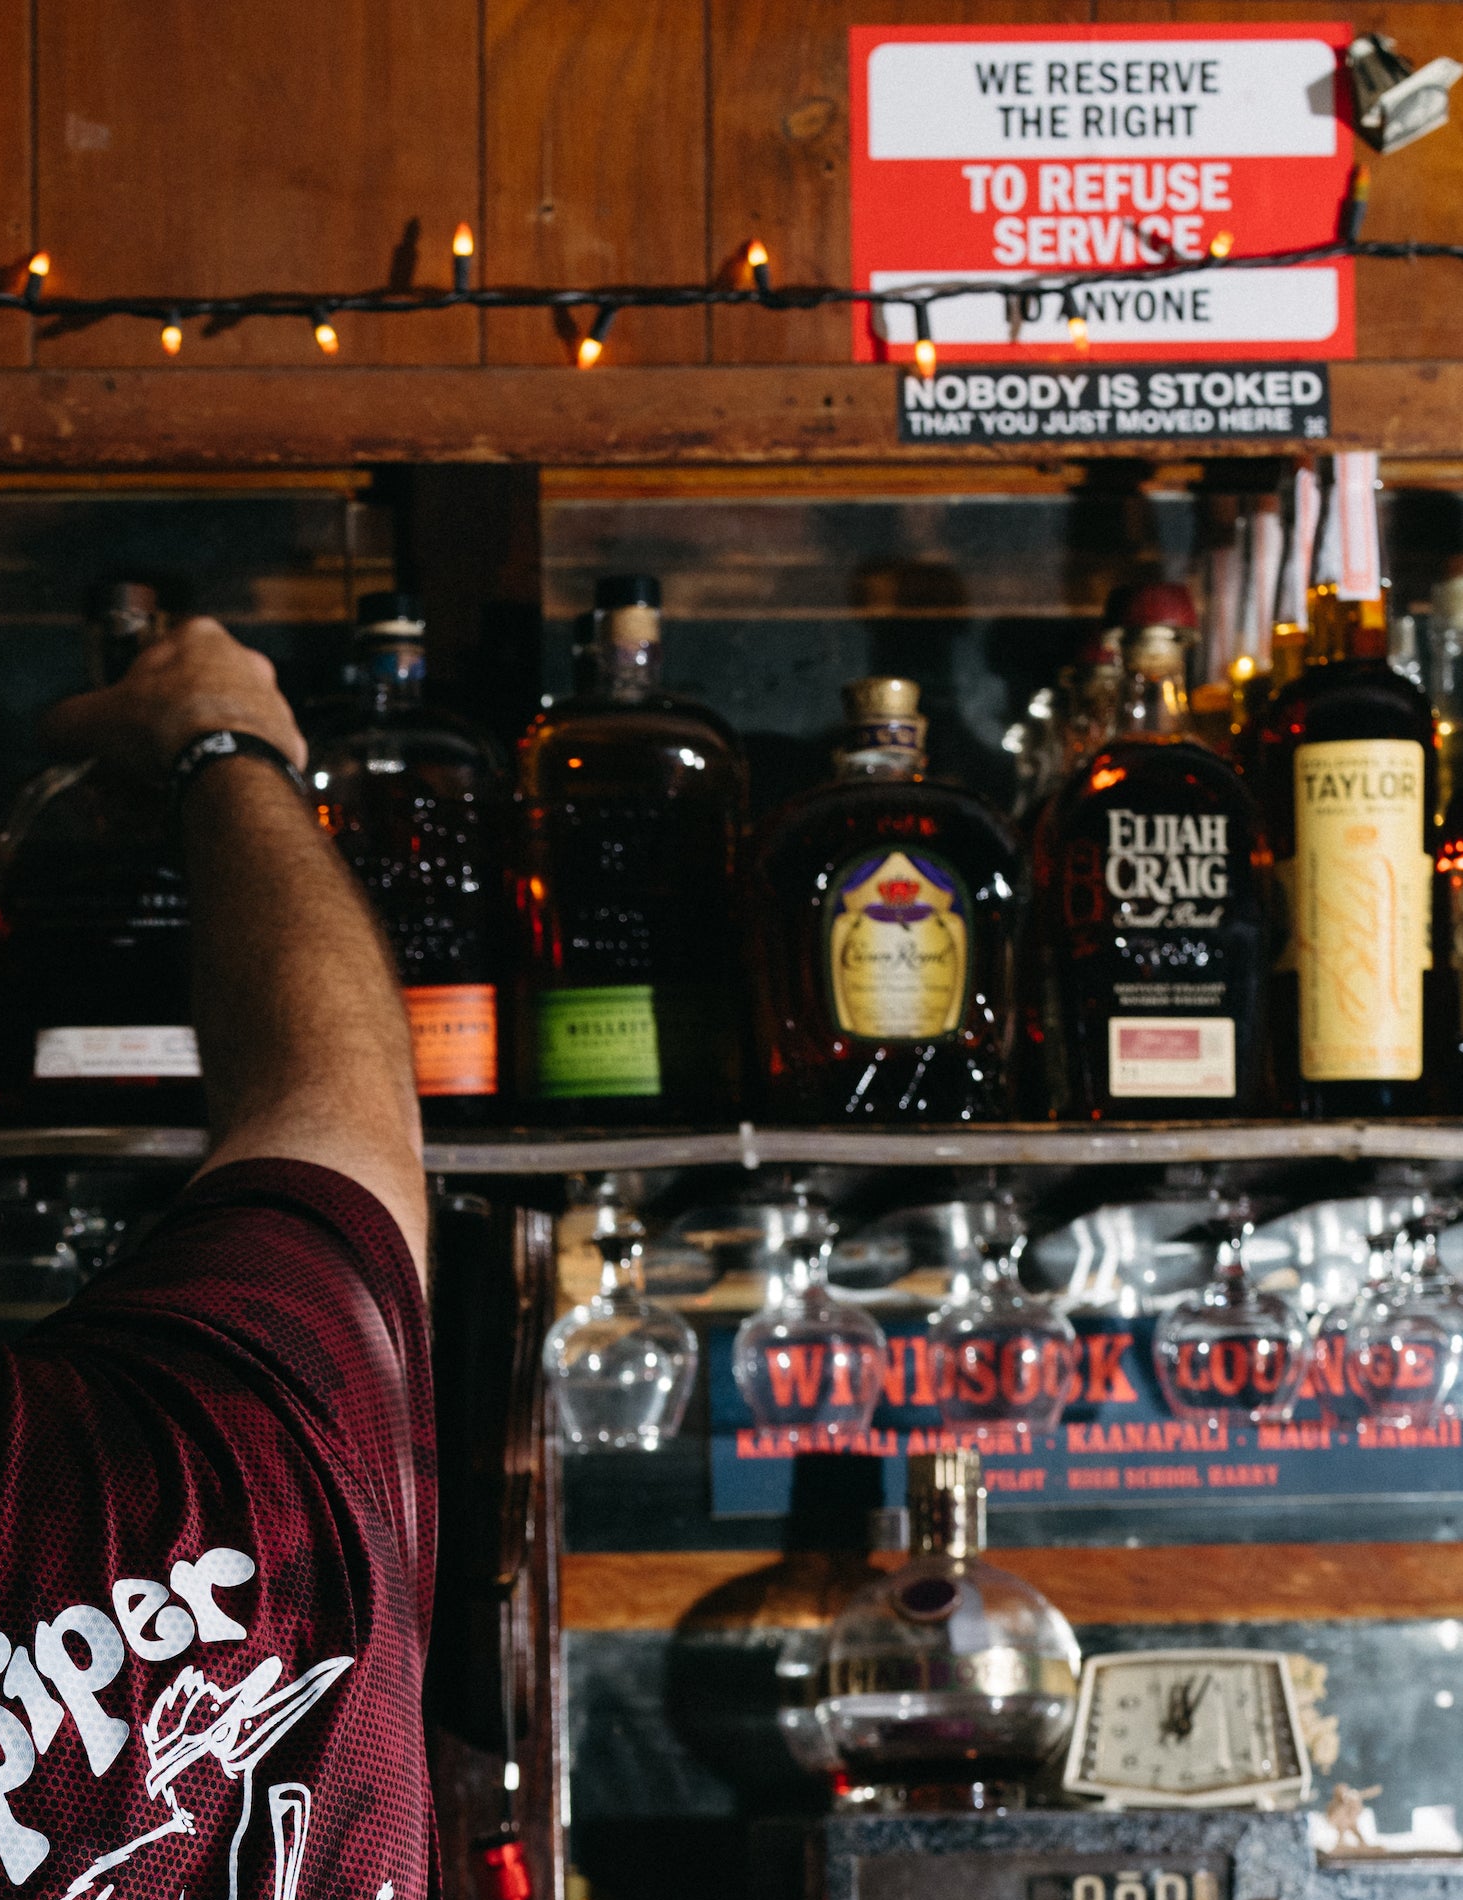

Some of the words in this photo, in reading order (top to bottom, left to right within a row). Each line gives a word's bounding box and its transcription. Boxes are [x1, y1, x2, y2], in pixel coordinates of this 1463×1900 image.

[976, 62, 1032, 96] WE
[1047, 60, 1221, 95] RESERVE
[997, 105, 1069, 138] THE
[1083, 104, 1200, 138] RIGHT
[962, 165, 1027, 212] TO
[1039, 163, 1232, 213] REFUSE
[993, 216, 1205, 266] SERVICE
[1058, 288, 1211, 322] NYONE
[904, 375, 1088, 411] NOBODY
[1098, 375, 1140, 408] IS
[1148, 371, 1324, 407] STOKED
[906, 411, 974, 436] THAT
[978, 411, 1035, 436] YOU
[1042, 410, 1112, 435] JUST
[1116, 408, 1215, 433] MOVED
[1219, 407, 1293, 432] HERE
[1303, 772, 1417, 801] TAYLOR
[1107, 809, 1228, 855] ELIJAH
[1105, 854, 1229, 904] CRAIG
[1067, 1420, 1229, 1454] KAANAPALI
